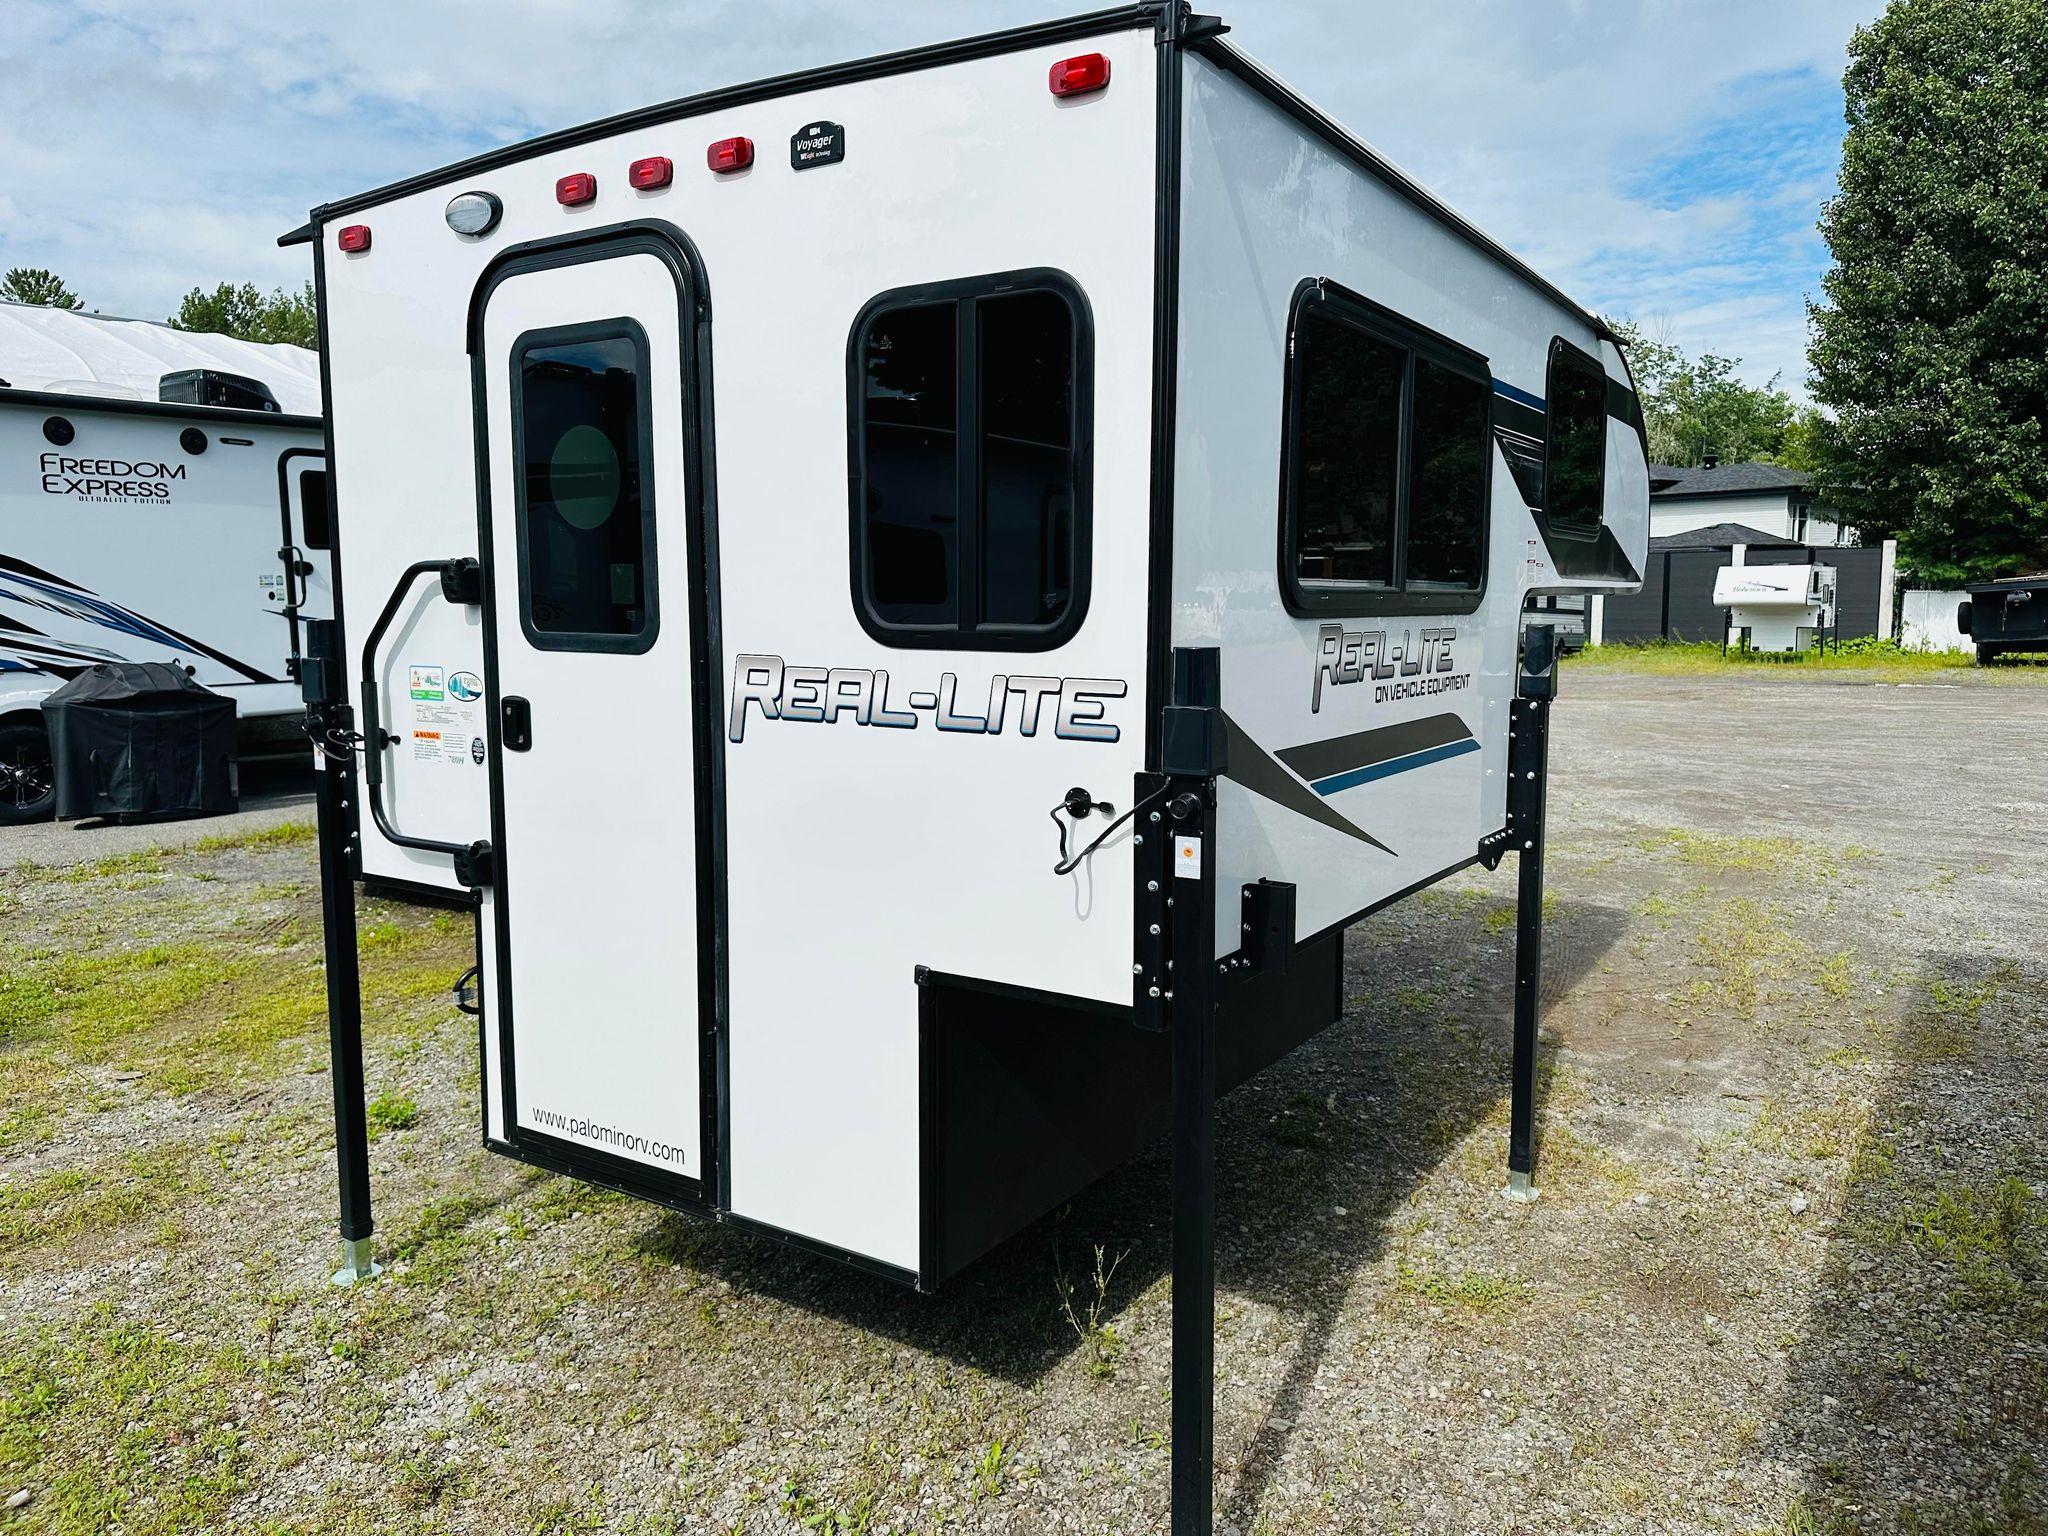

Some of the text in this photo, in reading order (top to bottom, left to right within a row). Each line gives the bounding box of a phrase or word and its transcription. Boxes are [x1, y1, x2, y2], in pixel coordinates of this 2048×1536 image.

[796, 135, 834, 151] Voyager
[40, 453, 186, 479] FREEDOM
[42, 474, 170, 498] EXPRESS
[79, 495, 128, 503] ULTRALITE
[1311, 623, 1457, 714] REAL-LITE
[728, 653, 1128, 744] REAL-LITE
[1375, 673, 1470, 704] ON VEHICLE EQUIPMENT
[532, 1107, 685, 1165] www.palominorv.com
